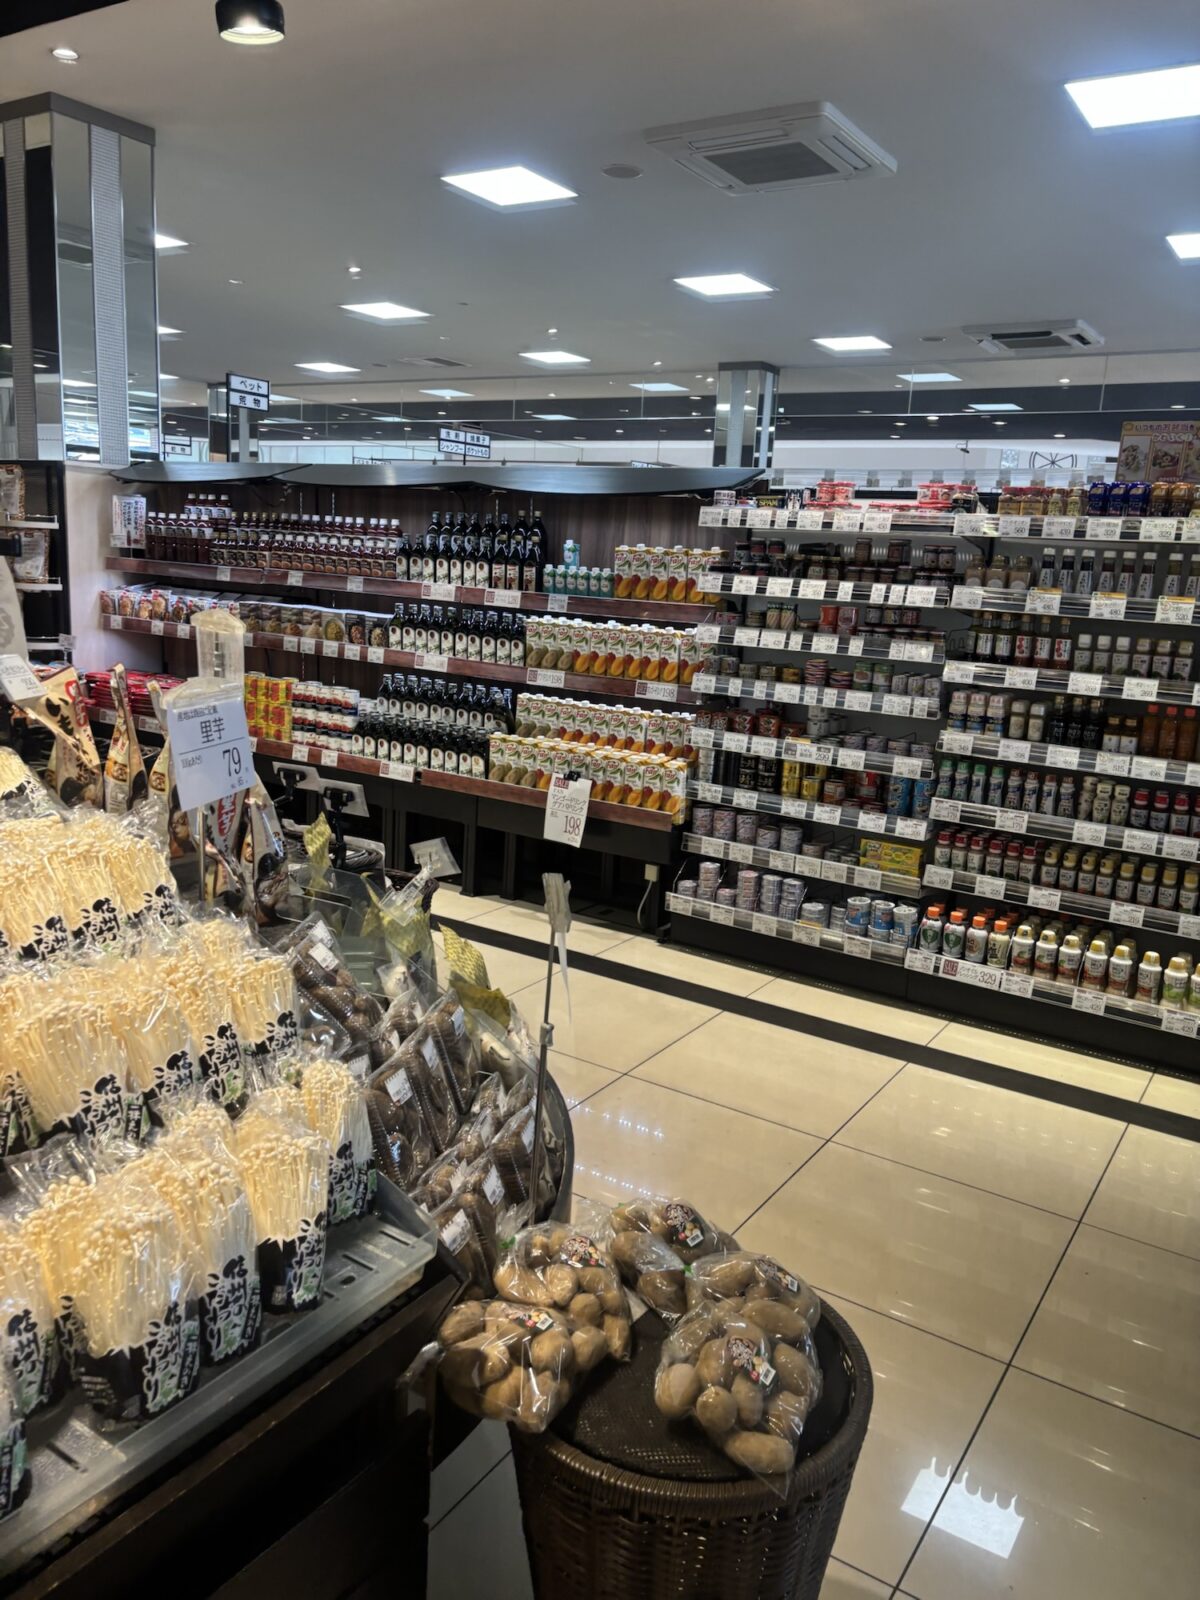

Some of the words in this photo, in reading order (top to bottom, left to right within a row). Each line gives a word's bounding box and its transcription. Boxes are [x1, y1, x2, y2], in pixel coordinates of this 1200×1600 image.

[200, 717, 225, 744] 里芋
[222, 747, 242, 777] 79
[815, 752, 829, 760] 299
[555, 778, 569, 788] SALE
[563, 815, 582, 836] 198
[979, 970, 996, 985] 329
[217, 1022, 241, 1071] 信州の
[223, 1254, 248, 1317] 信州の
[8, 1309, 42, 1374] 信州の
